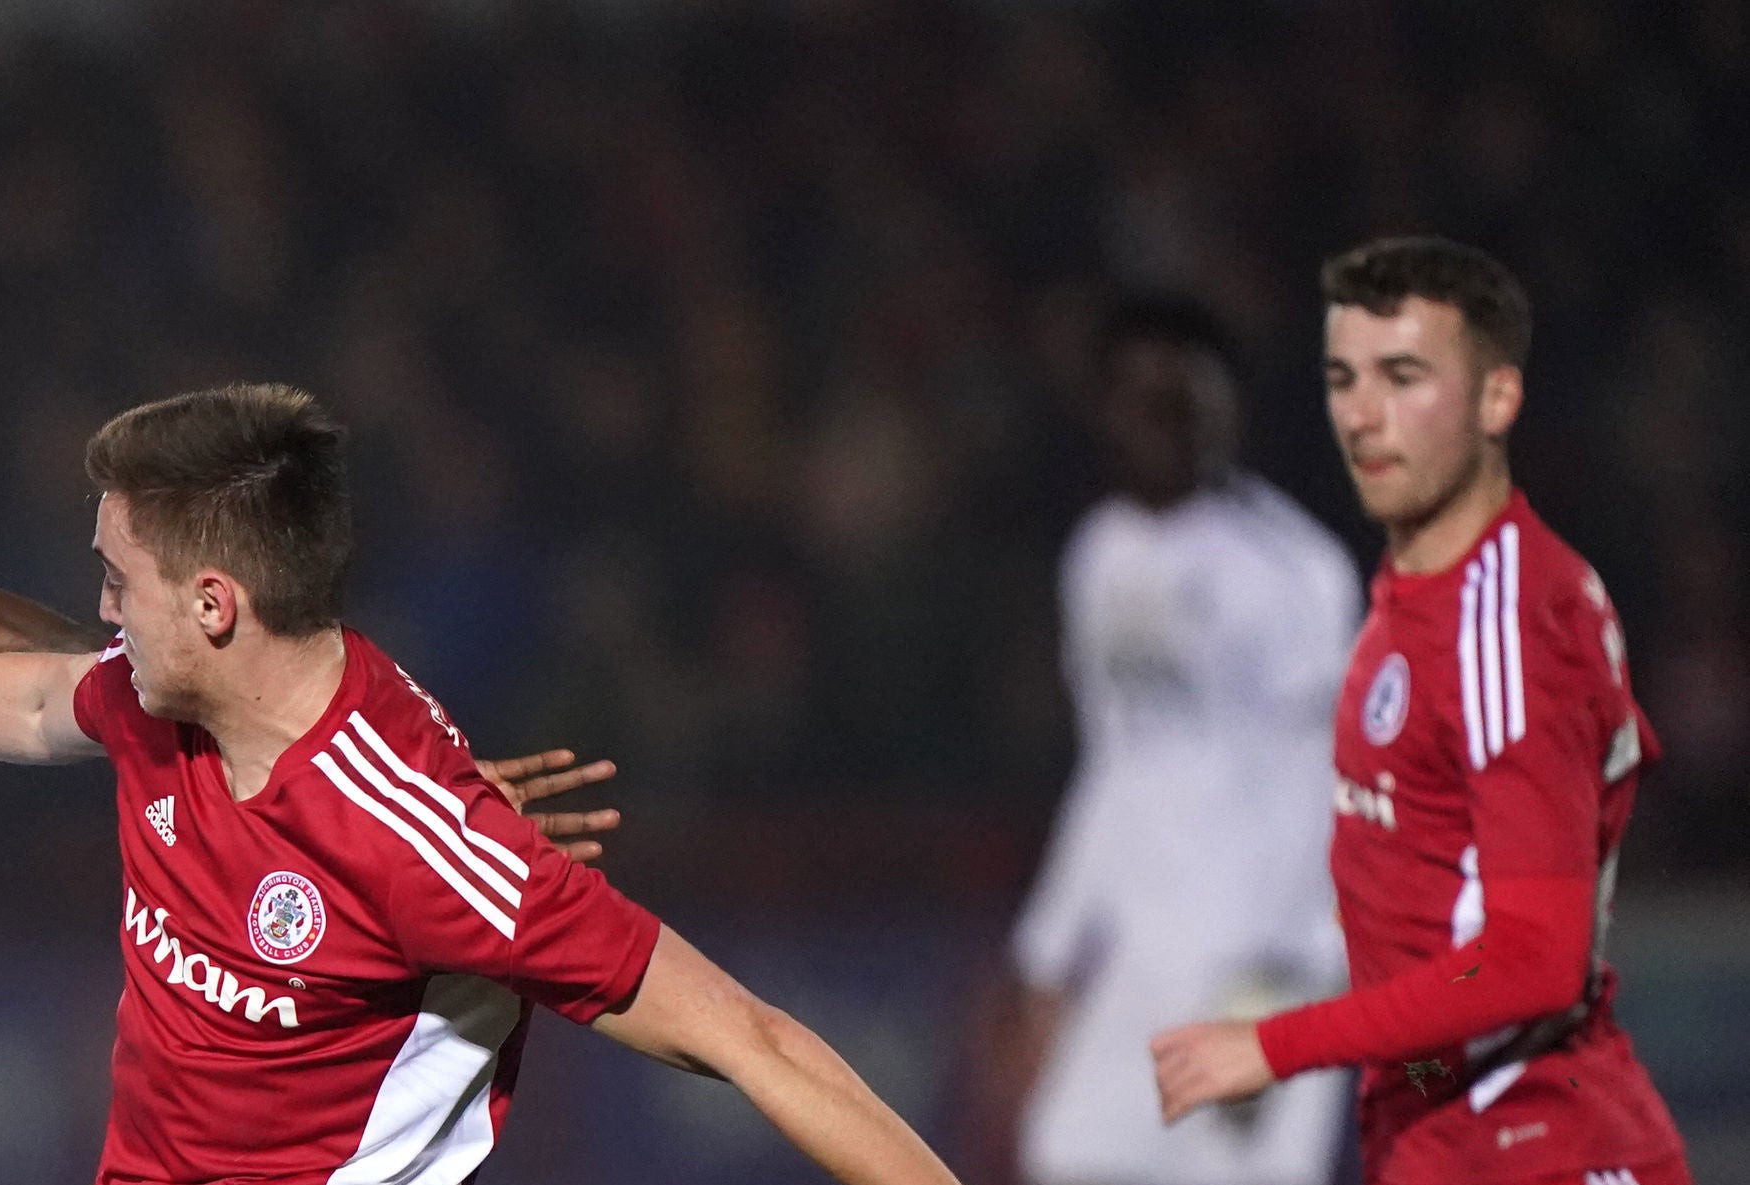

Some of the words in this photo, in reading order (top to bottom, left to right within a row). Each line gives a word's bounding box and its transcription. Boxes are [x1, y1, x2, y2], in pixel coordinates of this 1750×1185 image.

[144, 803, 178, 848] adidas
[258, 875, 307, 900] ACCRINGTON
[305, 886, 322, 931] STANLEY
[251, 912, 280, 958] FOOTBALL
[283, 940, 311, 958] CLUB
